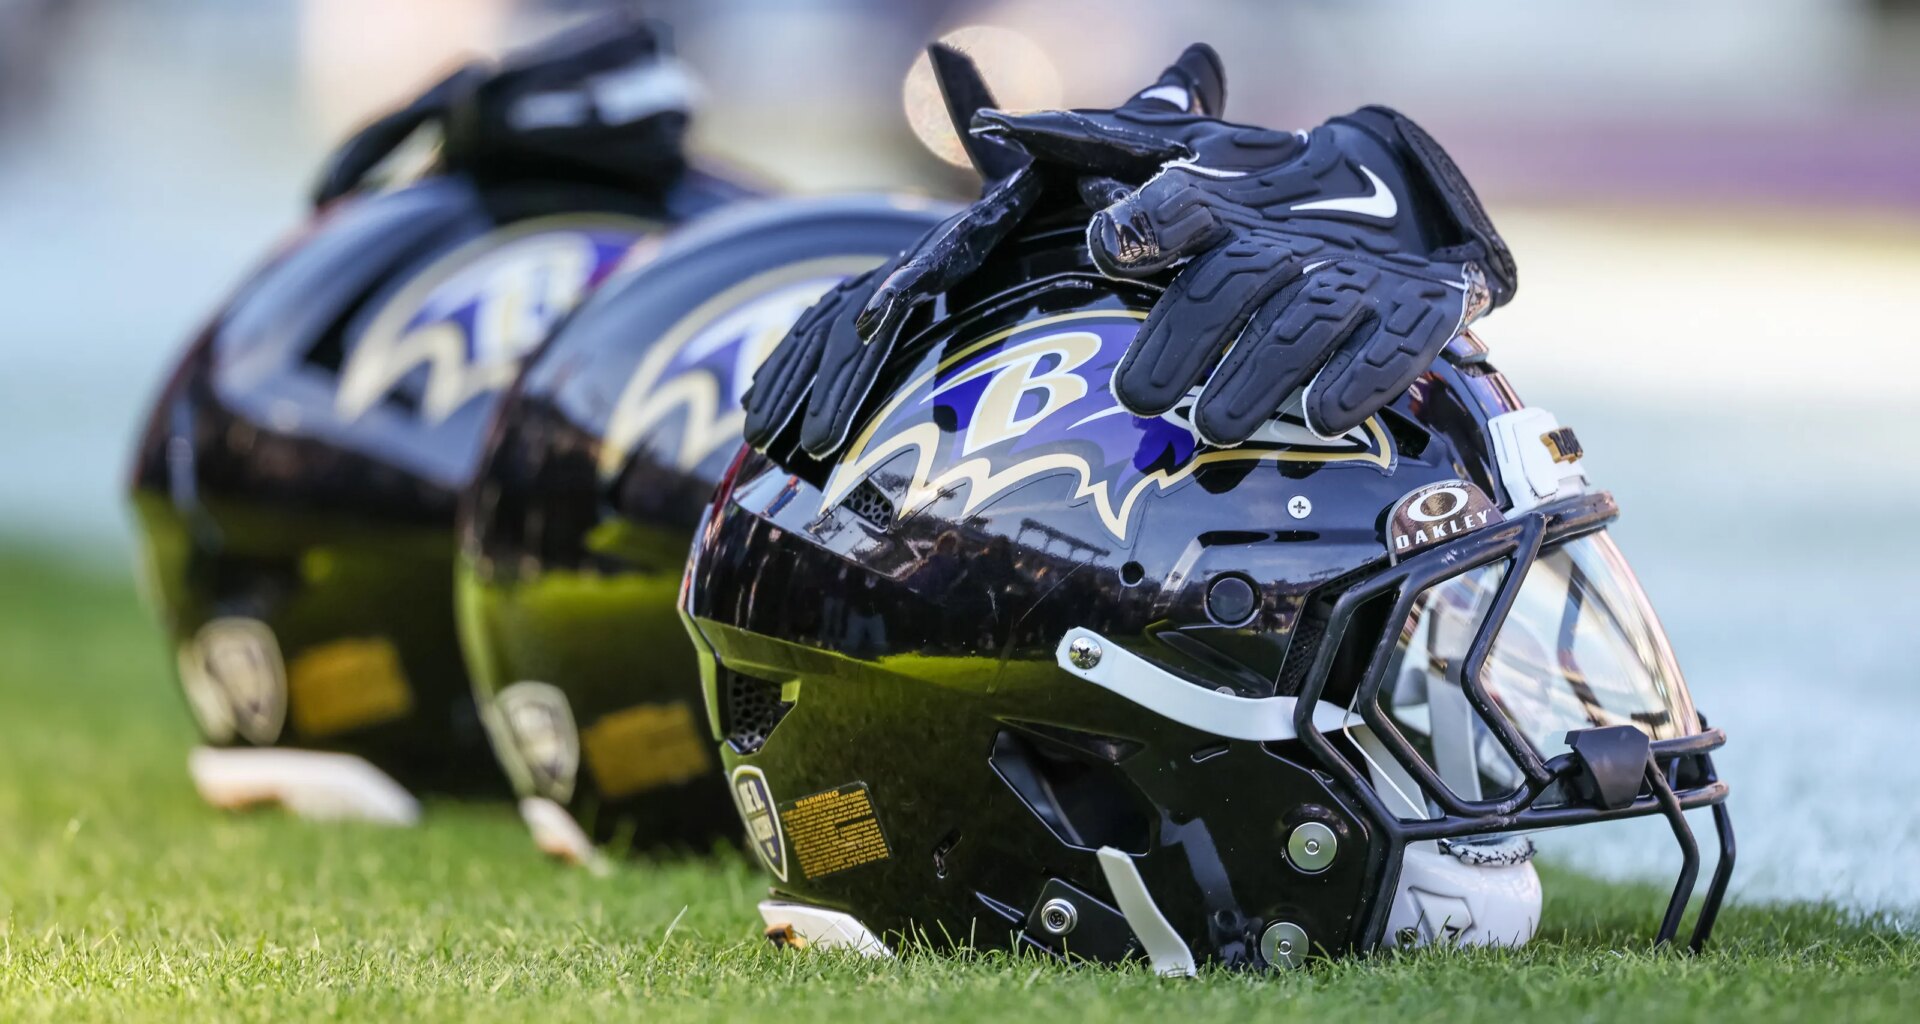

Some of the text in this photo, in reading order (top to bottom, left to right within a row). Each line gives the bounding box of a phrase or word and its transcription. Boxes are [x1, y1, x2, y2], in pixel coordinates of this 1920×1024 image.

[919, 331, 1102, 458] B
[1395, 509, 1489, 549] OAKLEY
[795, 790, 840, 809] WARNING
